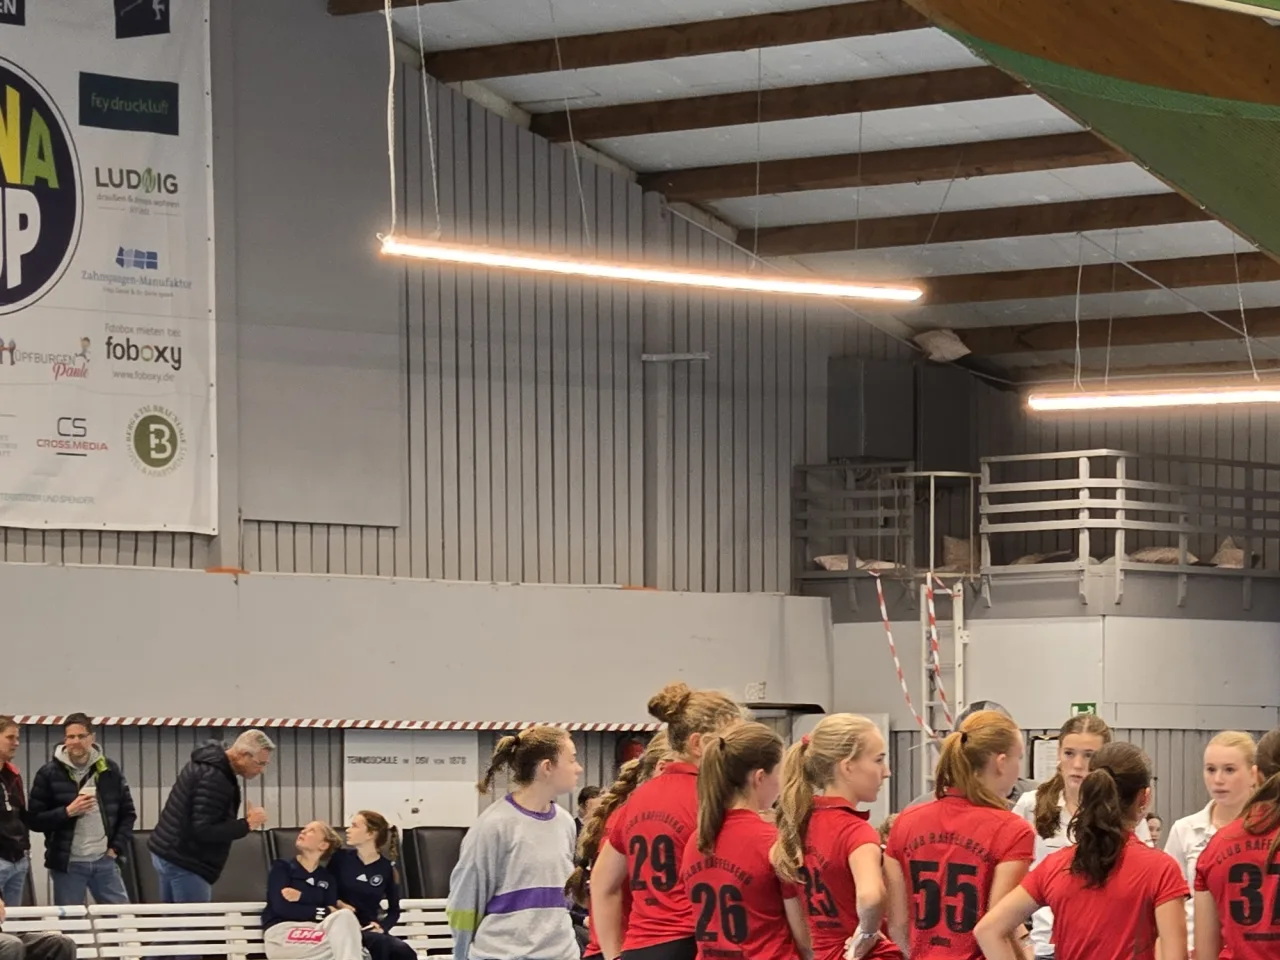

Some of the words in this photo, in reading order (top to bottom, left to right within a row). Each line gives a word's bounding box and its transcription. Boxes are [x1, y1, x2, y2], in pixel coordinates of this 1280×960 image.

[105, 336, 182, 371] foboxy
[57, 417, 87, 437] CS
[629, 834, 678, 892] 29
[1215, 843, 1242, 865] CLUB
[691, 882, 748, 945] 26
[909, 860, 978, 933] 55
